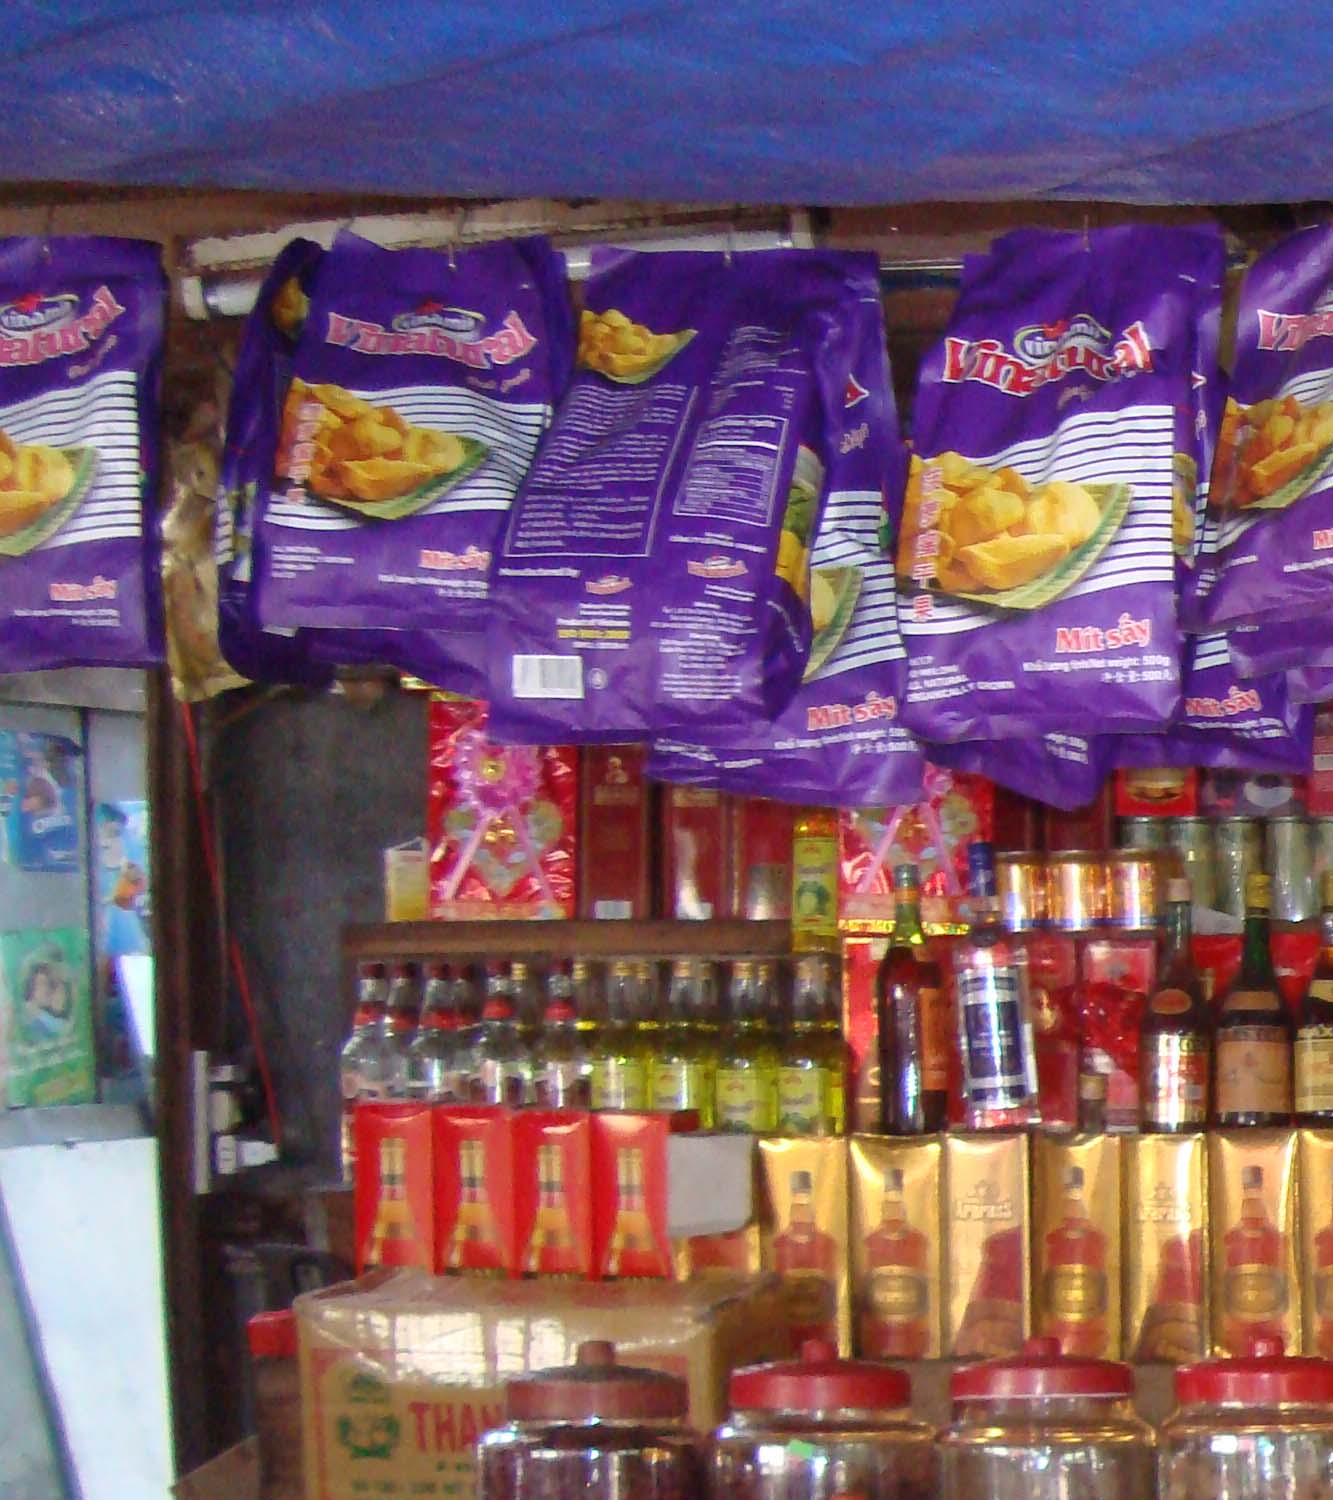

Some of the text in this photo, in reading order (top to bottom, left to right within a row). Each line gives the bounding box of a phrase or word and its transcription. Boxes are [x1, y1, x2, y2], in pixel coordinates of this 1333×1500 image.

[1056, 613, 1153, 654] Mít sấy
[806, 691, 897, 731] Mít sấy
